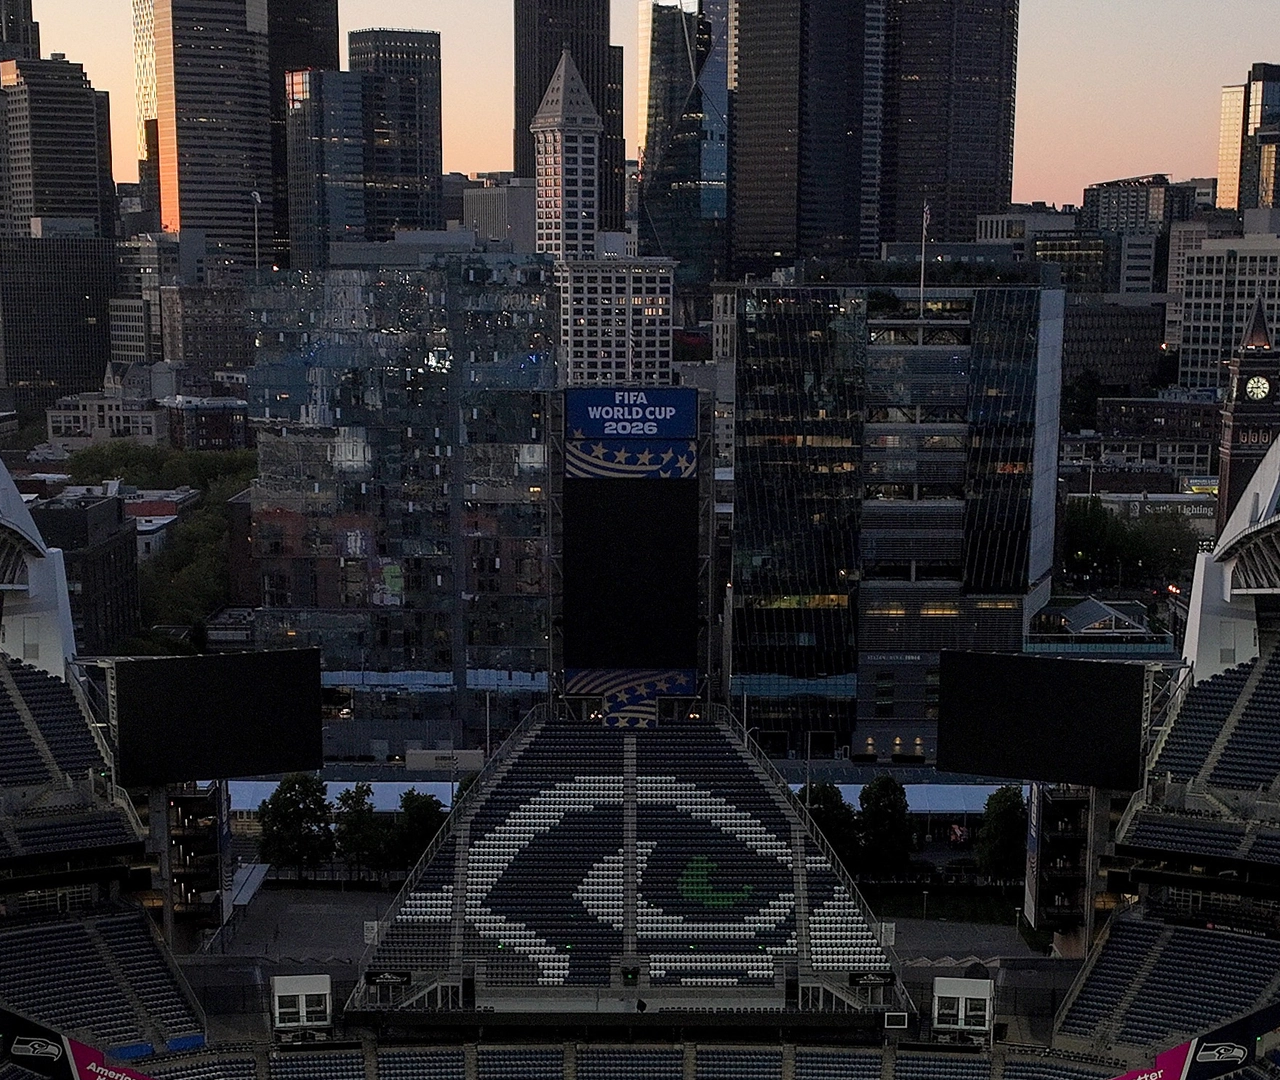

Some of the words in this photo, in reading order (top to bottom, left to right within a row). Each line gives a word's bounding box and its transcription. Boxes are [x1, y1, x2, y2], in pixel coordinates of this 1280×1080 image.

[615, 392, 648, 405] FIFA
[588, 407, 643, 420] WORLD
[645, 407, 676, 420] CUP
[604, 421, 658, 435] 2026
[1178, 504, 1214, 516] Lighting
